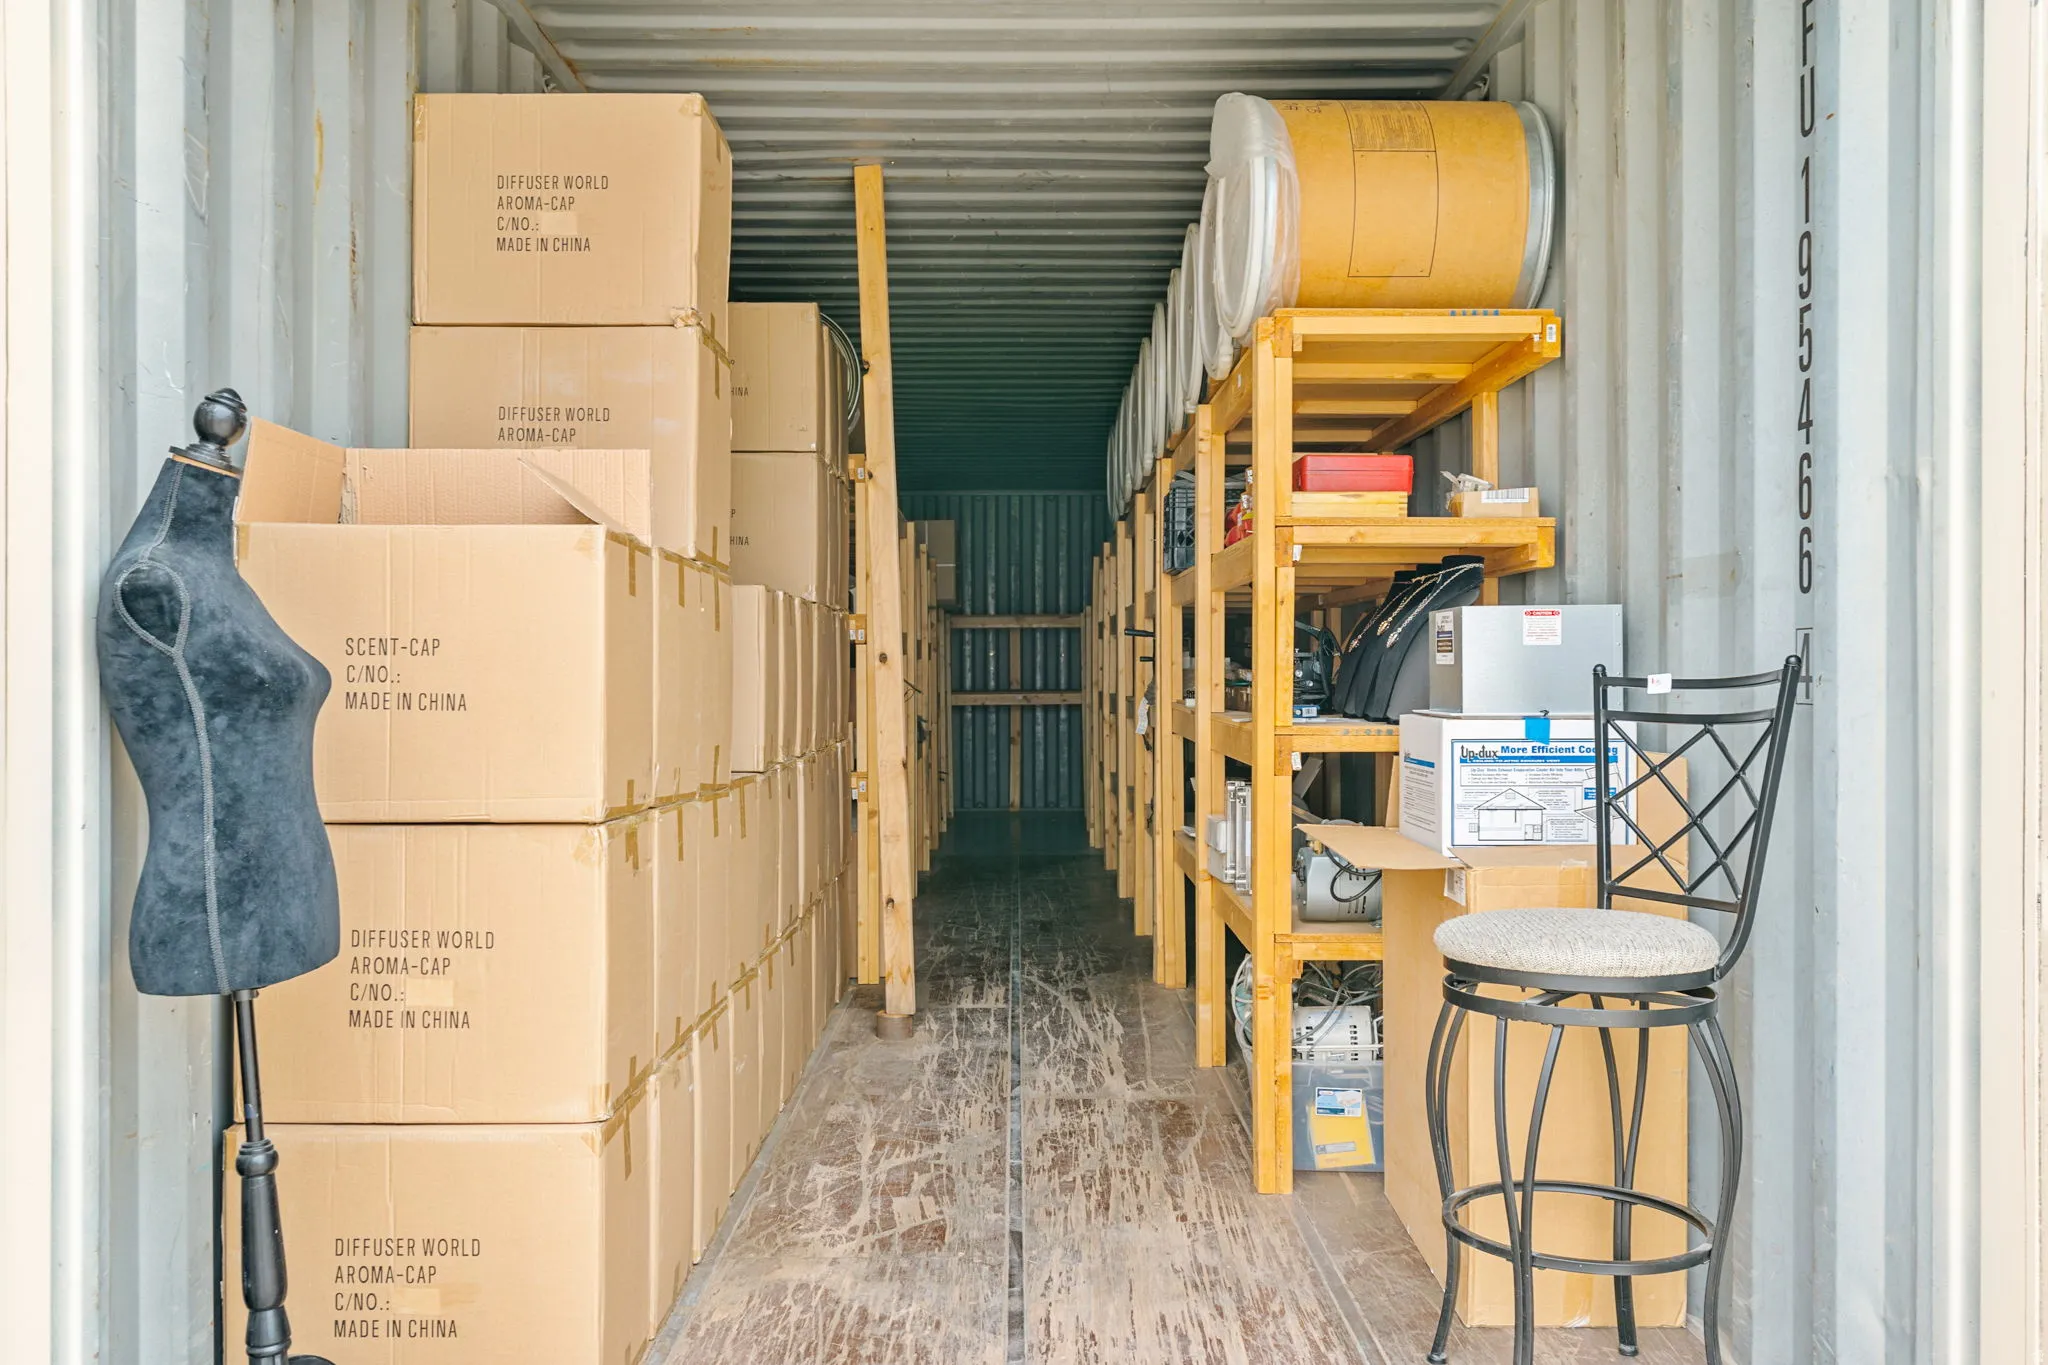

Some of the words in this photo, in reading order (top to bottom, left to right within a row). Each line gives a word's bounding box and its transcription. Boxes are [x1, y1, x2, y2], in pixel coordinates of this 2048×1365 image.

[496, 174, 560, 190] DIFFUSER
[563, 175, 609, 190] WORLD
[496, 195, 575, 211] AROMA-CAP
[497, 216, 540, 231] C/NO.:
[496, 237, 532, 252] MADE
[536, 237, 549, 252] IN
[552, 237, 591, 252] CHINA
[1797, 155, 1814, 595] 195466
[498, 406, 561, 422] DIFFUSER
[565, 407, 611, 422] WORLD
[497, 427, 577, 443] AROMA-CAP
[729, 535, 750, 546] HINA
[345, 637, 441, 657] SCENT-CAP
[346, 664, 401, 684] C/NO.:
[345, 691, 391, 711] MADE
[397, 692, 412, 711] IN
[418, 692, 467, 712] CHINA
[1500, 745, 1528, 755] More
[1531, 745, 1576, 755] Efficient
[1578, 745, 1619, 757] Coog
[351, 929, 431, 949] DIFFUSER
[437, 930, 495, 949] WORLD
[350, 956, 451, 976] AROMA-CAP
[350, 982, 405, 1002] C/NO.:
[348, 1009, 394, 1029] MADE
[400, 1010, 416, 1029] IN
[421, 1010, 471, 1029] CHINA
[335, 1237, 416, 1257] DIFFUSER
[422, 1238, 481, 1257] WORLD
[335, 1265, 437, 1285] AROMA-CAP
[335, 1292, 390, 1312] C/NO.:
[334, 1319, 380, 1339] MADE
[386, 1319, 402, 1339] IN
[408, 1319, 458, 1339] CHINA
